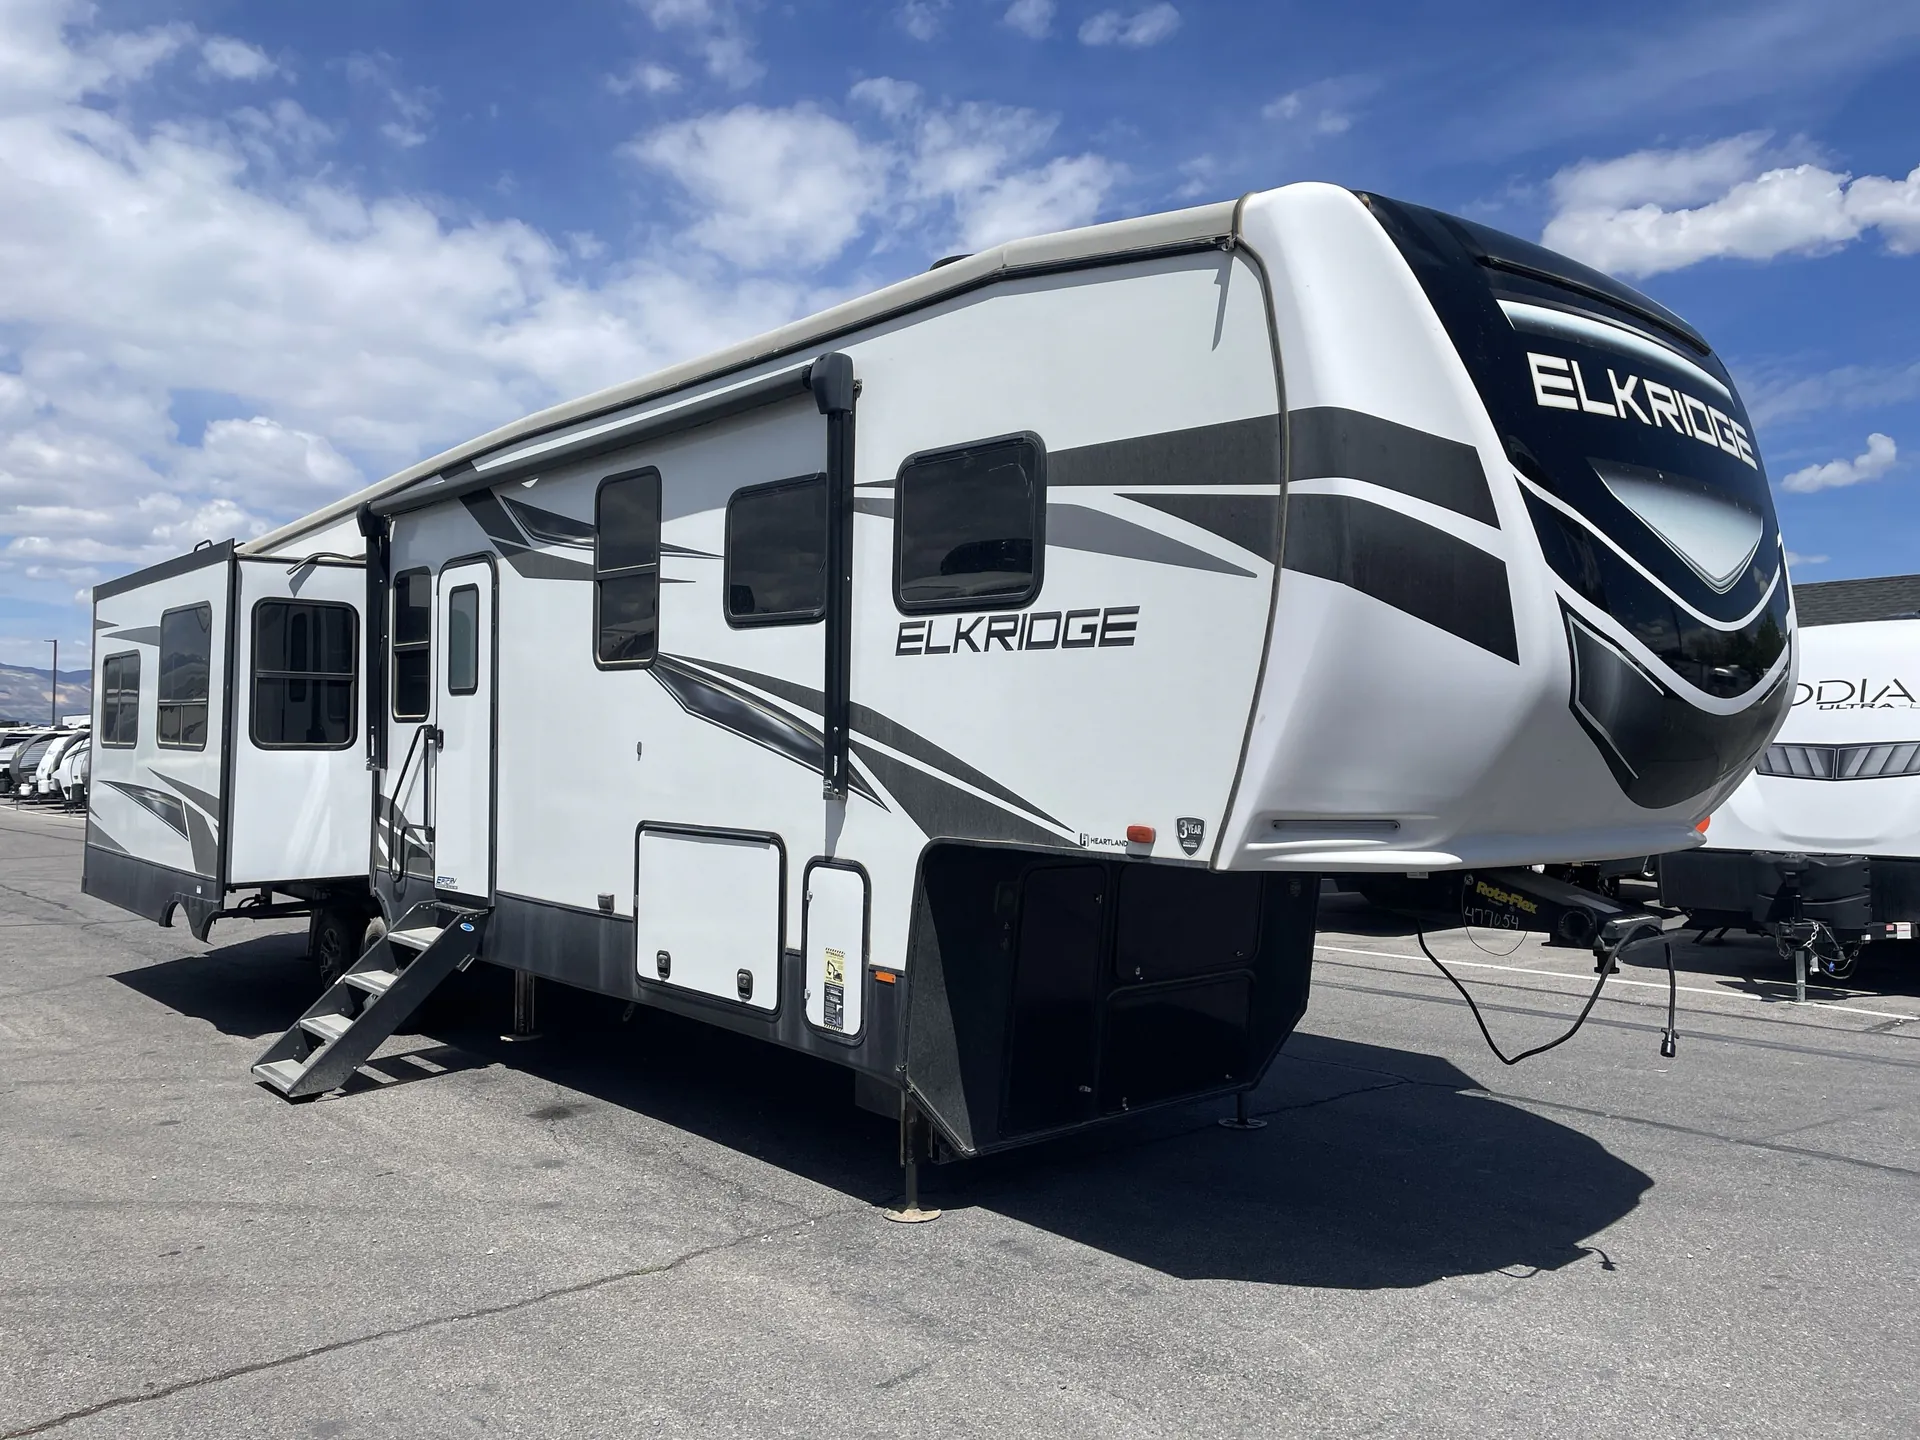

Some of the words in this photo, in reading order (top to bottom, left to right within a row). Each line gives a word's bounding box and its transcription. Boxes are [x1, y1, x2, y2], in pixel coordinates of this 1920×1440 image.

[1526, 351, 1758, 471] ELKRIDGE
[895, 605, 1140, 656] ELKRIDGE
[1090, 837, 1129, 847] HEARTLAND
[1179, 819, 1188, 839] 3
[1187, 824, 1202, 835] YEAR
[1476, 881, 1538, 914] Rota-Flex
[1464, 906, 1519, 930] 477054
